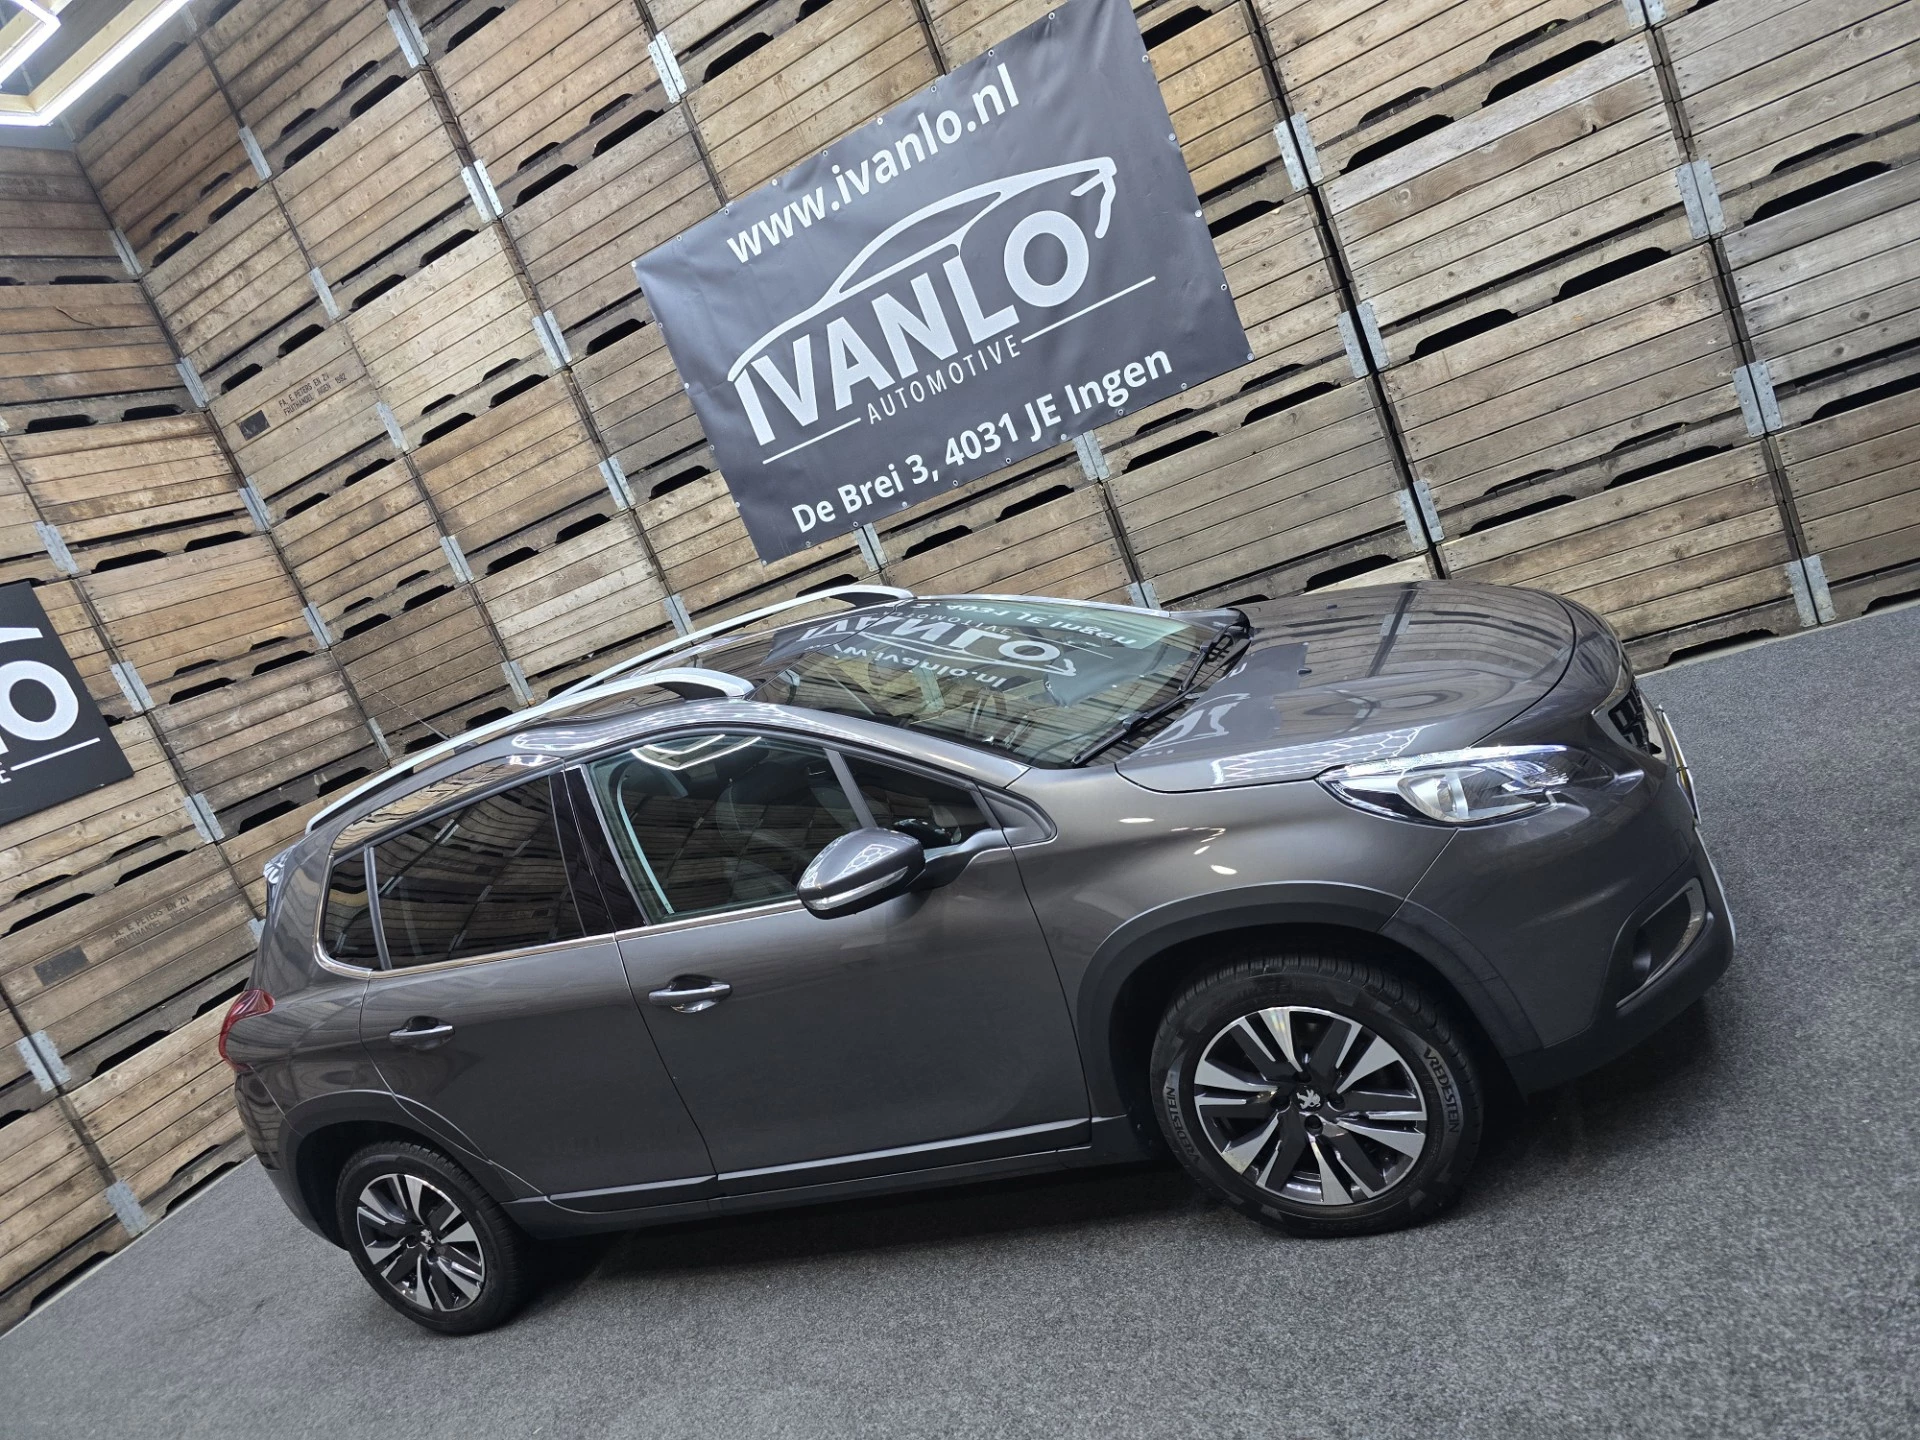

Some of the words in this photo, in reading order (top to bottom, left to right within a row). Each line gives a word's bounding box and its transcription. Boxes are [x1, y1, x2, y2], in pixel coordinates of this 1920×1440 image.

[725, 62, 1020, 264] www.ivanlo.nl
[733, 209, 1090, 447] IVANLO
[295, 382, 313, 398] PETERS
[867, 334, 1021, 425] AUTOMOTIVE
[791, 499, 836, 533] De
[838, 463, 904, 515] Brei
[910, 454, 940, 482] 3,
[945, 413, 1020, 468] 4031
[1024, 393, 1062, 443] JE
[1066, 349, 1174, 408] Ingen
[1164, 1085, 1202, 1163] VREDESTEIN
[1421, 1047, 1461, 1134] VREDESTEIN
